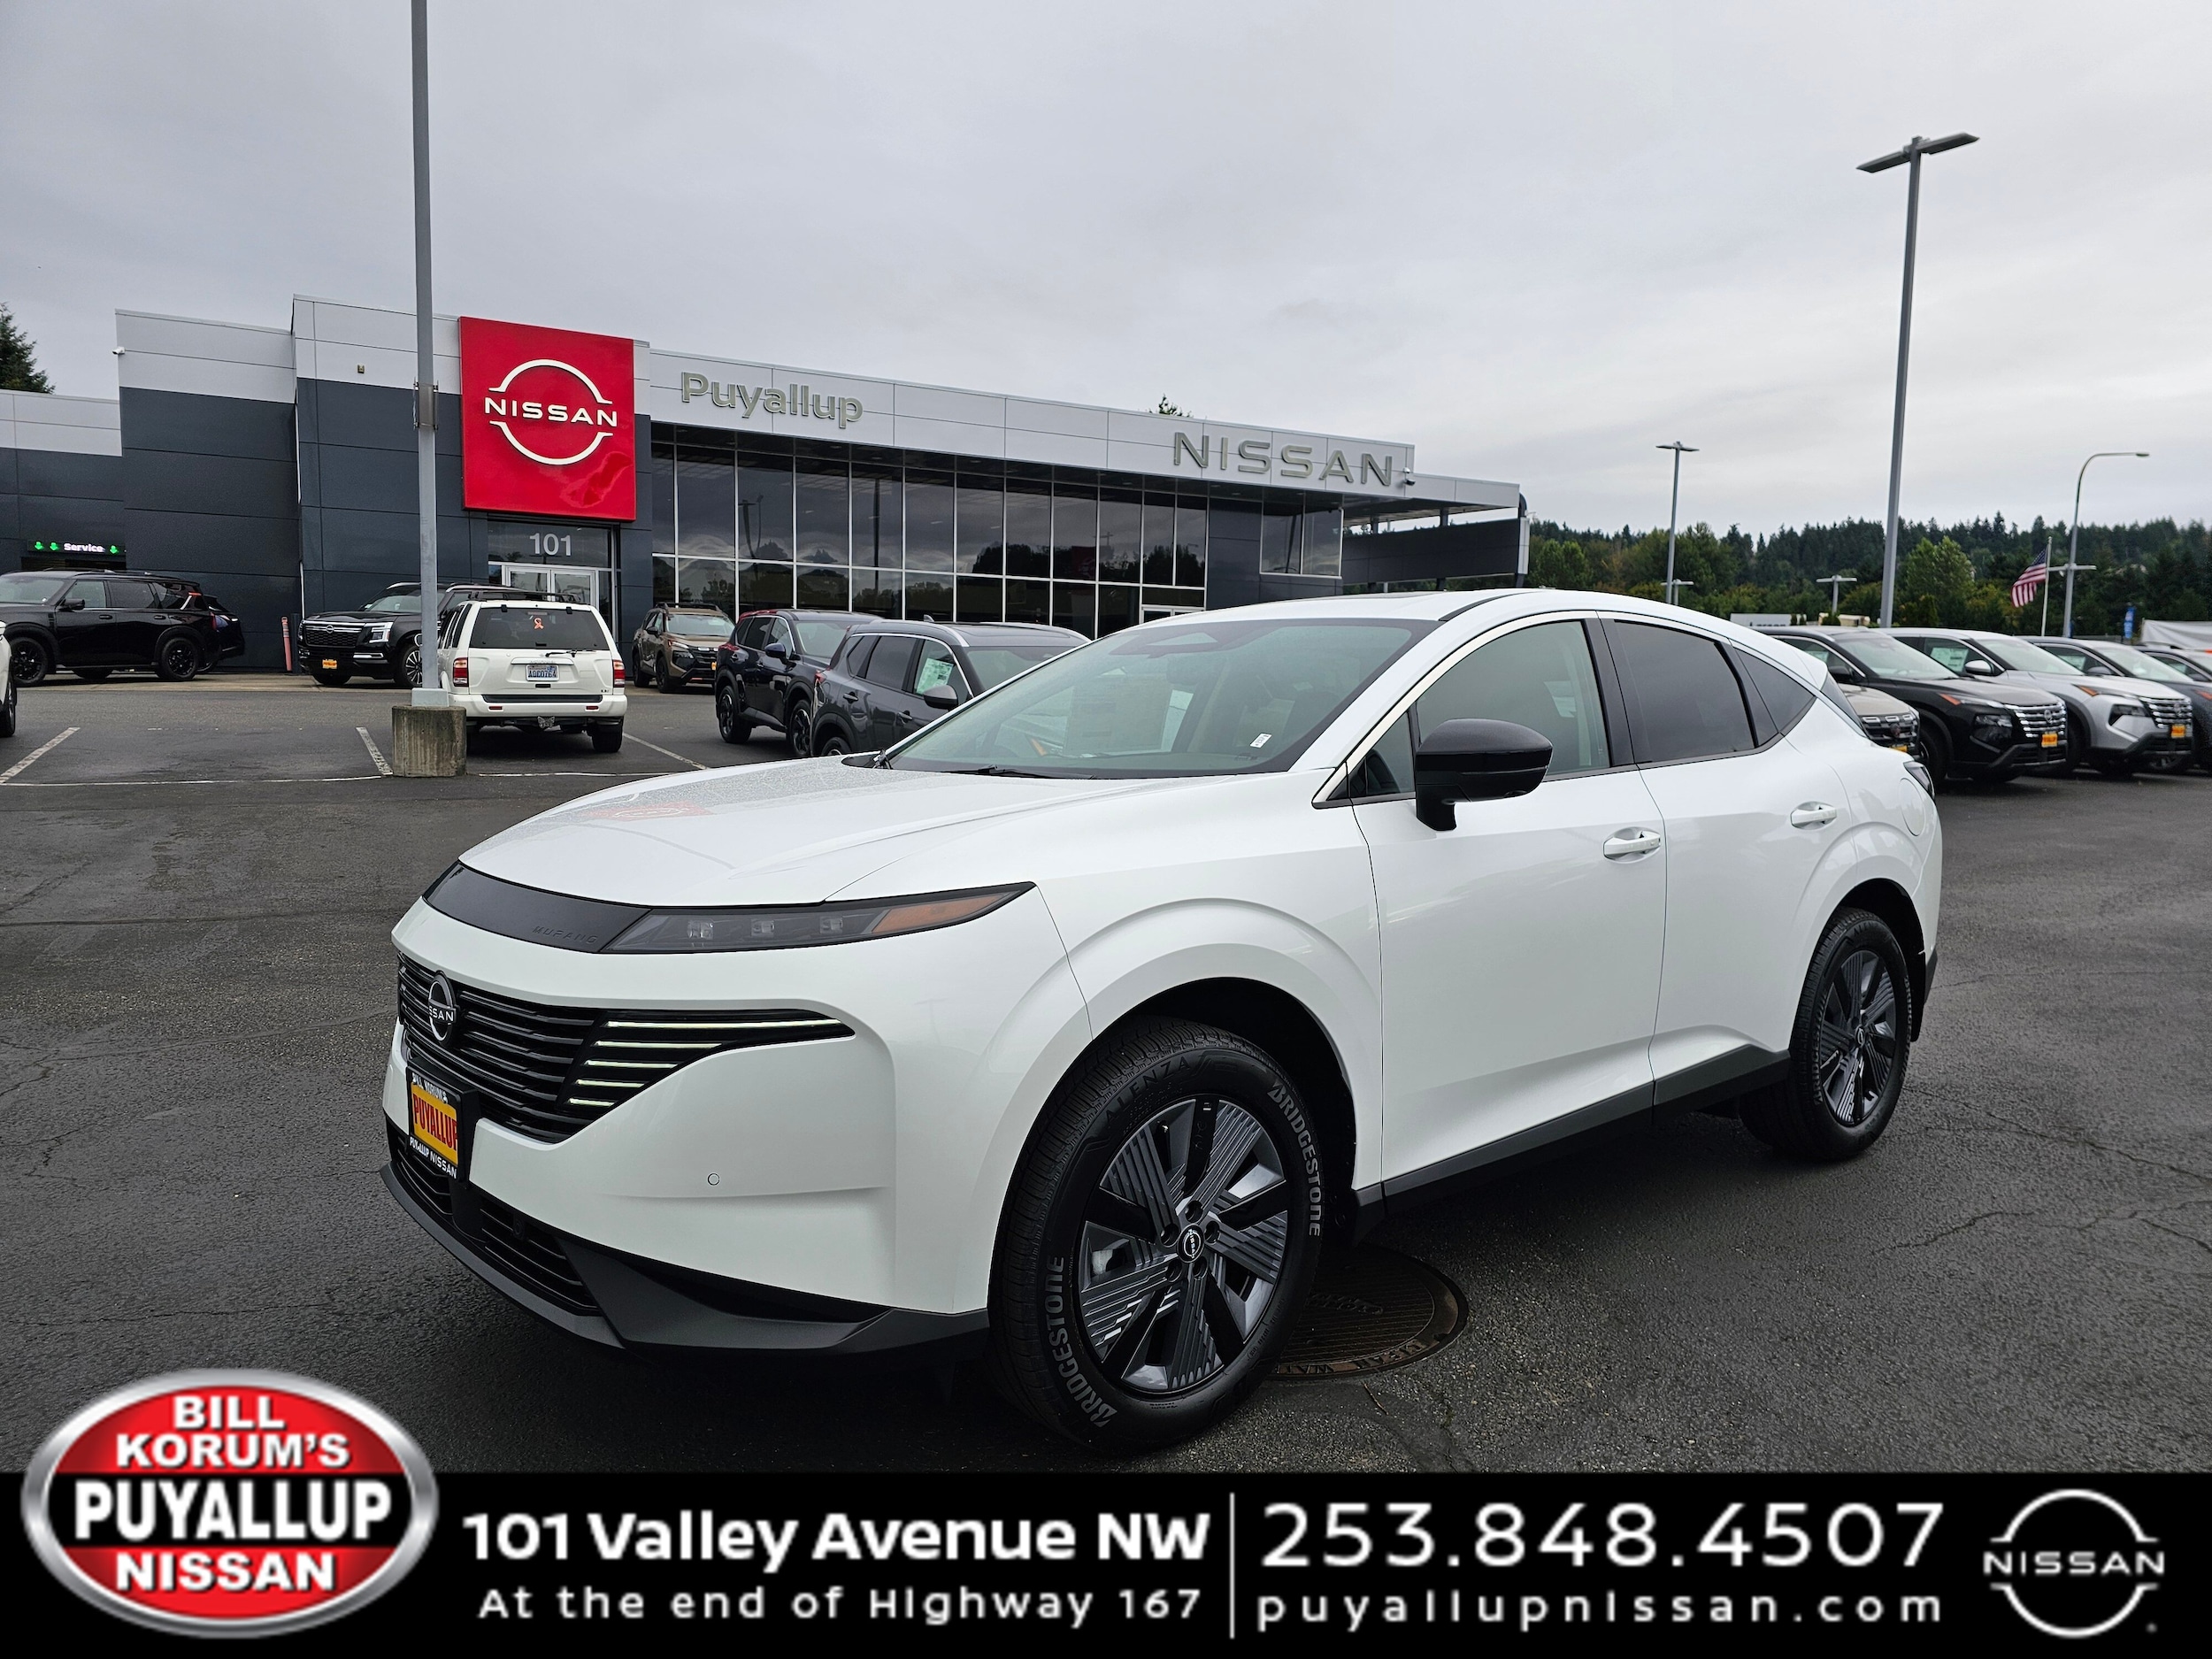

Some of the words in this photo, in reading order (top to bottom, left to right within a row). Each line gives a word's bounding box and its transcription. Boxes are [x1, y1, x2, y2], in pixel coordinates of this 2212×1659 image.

[484, 396, 618, 428] NISSAN
[680, 371, 864, 430] Puyallup
[1173, 431, 1394, 487] NISSAN
[64, 542, 105, 553] Service
[529, 533, 572, 557] 101
[1105, 1056, 1192, 1123] ALENZA
[429, 1152, 457, 1179] NISSAN
[1266, 1079, 1323, 1238] BRIDGESTONE
[1044, 1256, 1118, 1429] BRIDGESTONE
